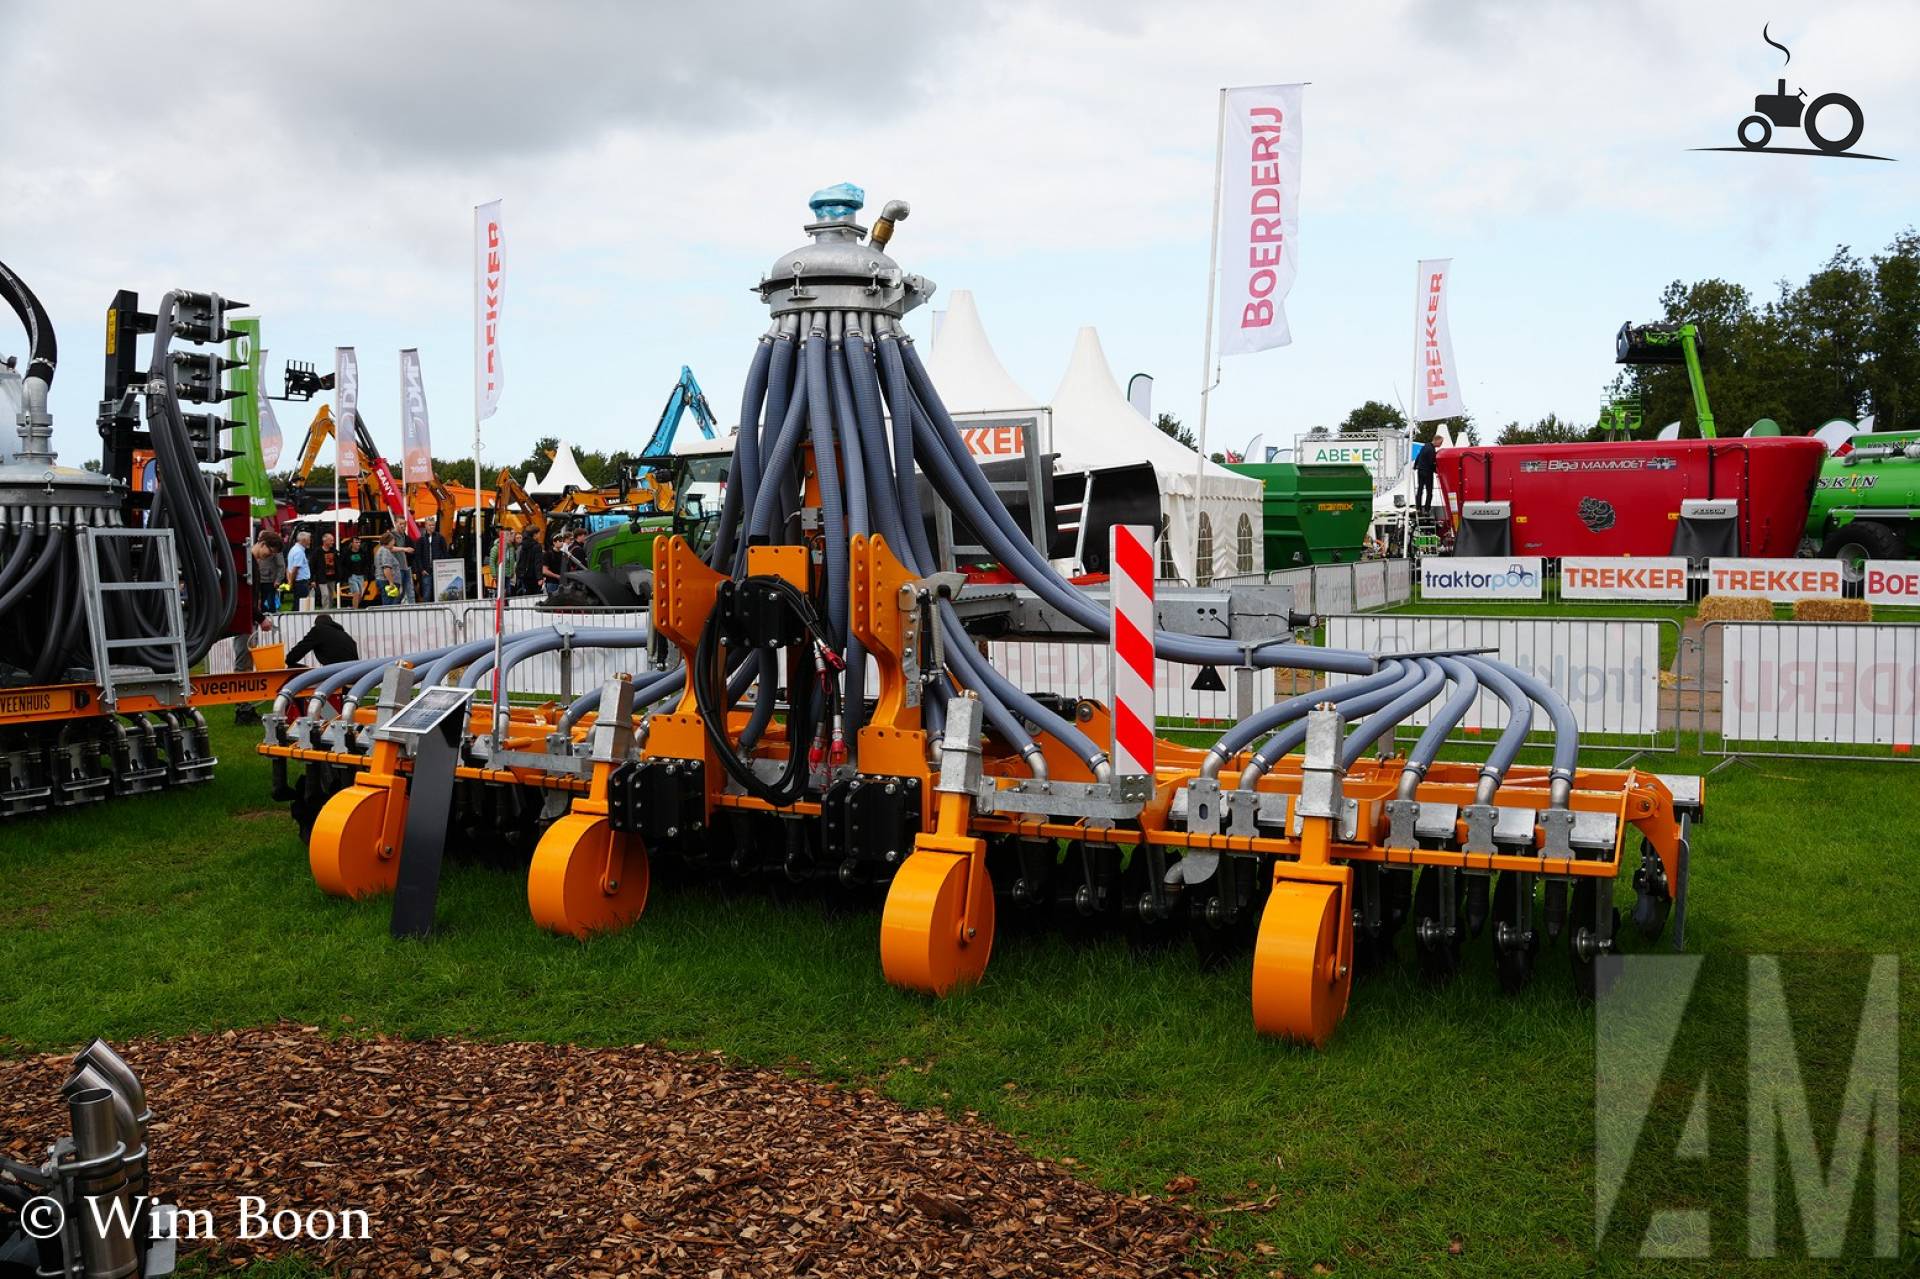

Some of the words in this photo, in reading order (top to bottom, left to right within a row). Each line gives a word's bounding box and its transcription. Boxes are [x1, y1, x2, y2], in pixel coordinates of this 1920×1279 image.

[1241, 107, 1283, 329] BOERDERIJ
[1425, 272, 1448, 406] TREKKER
[1425, 570, 1538, 591] traktorpool
[1564, 568, 1684, 589] TREKKER
[1712, 570, 1840, 592] TREKKER
